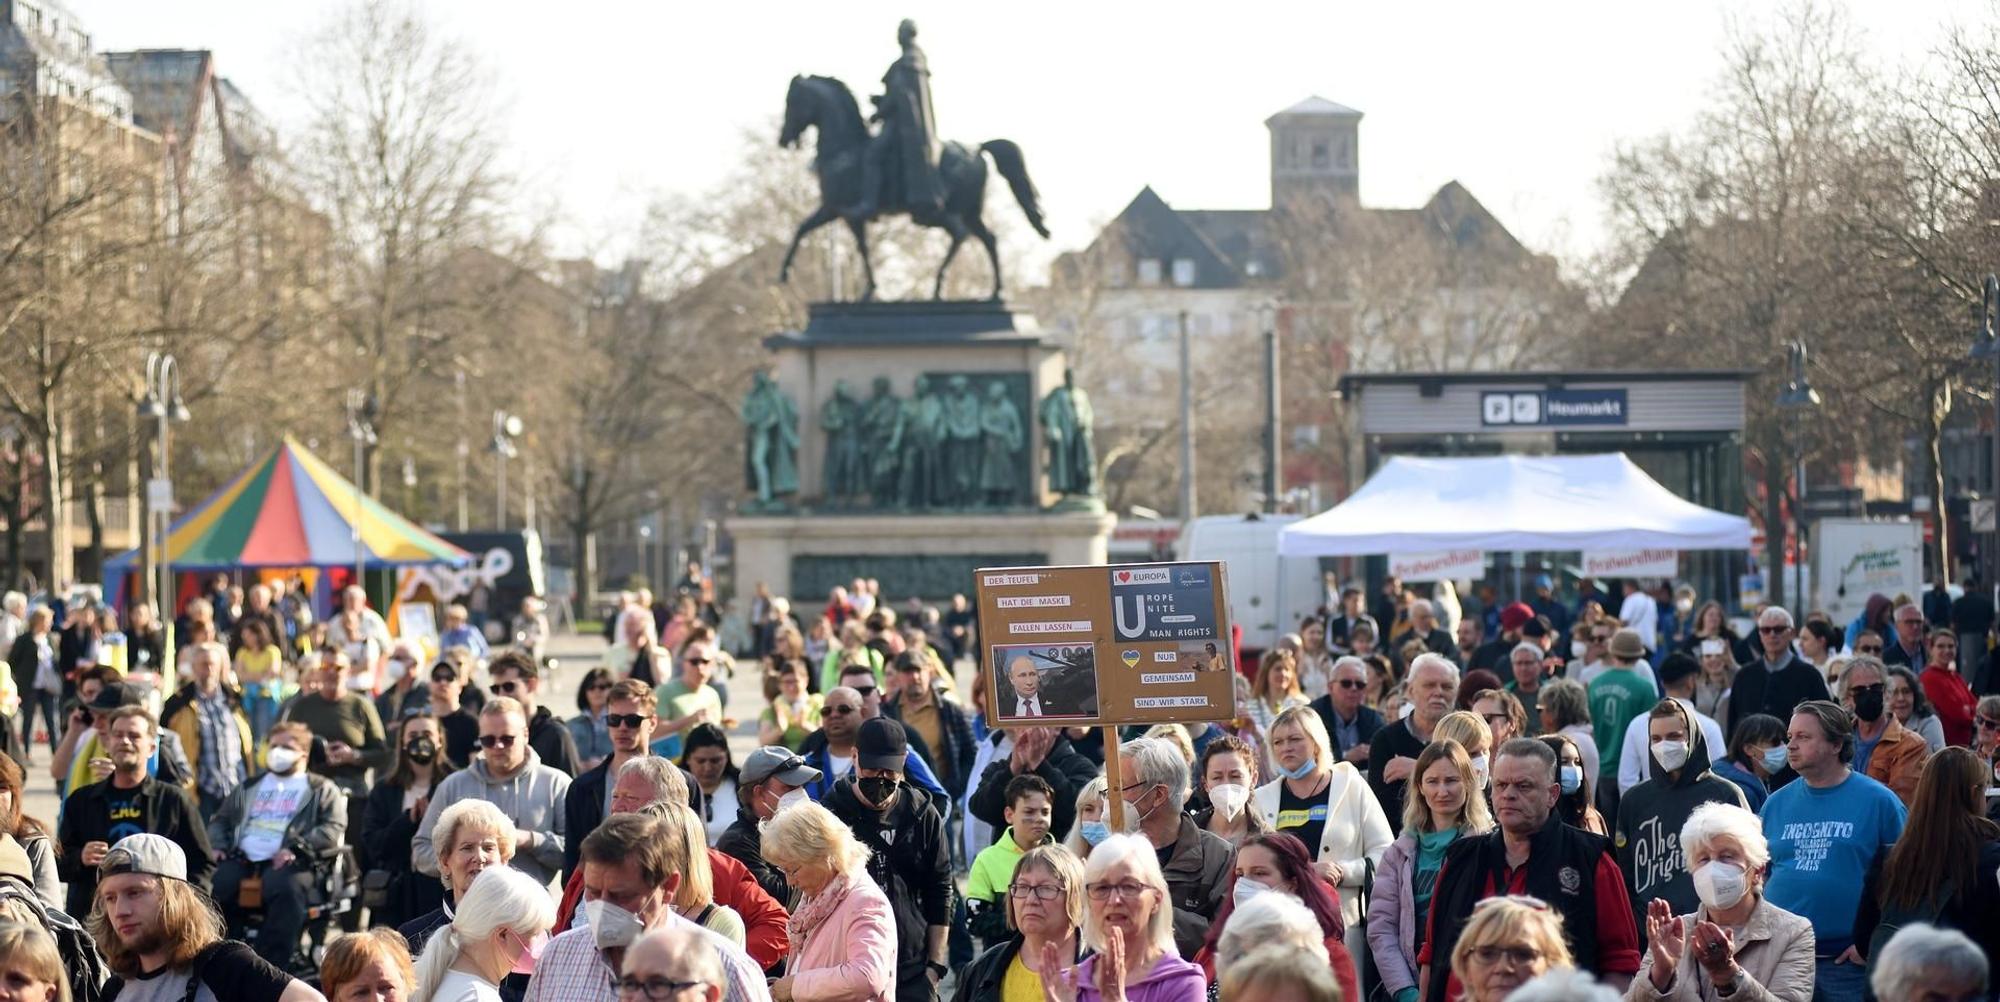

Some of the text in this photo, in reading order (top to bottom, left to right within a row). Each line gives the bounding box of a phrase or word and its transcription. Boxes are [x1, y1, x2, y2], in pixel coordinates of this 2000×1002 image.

[1548, 398, 1621, 416] Heumarkt
[989, 575, 1034, 585] DER TEUFEL
[1133, 572, 1167, 581] EUROPA
[1001, 597, 1065, 607] HAT DIE MASKE
[1146, 593, 1174, 602] ROPE
[1147, 605, 1175, 613] NITE
[1114, 595, 1146, 638] U
[1013, 624, 1040, 632] FALLEN
[1149, 627, 1211, 637] MAN RIGHTS
[1157, 653, 1175, 661] NUR
[1144, 673, 1193, 682] GEMEINSAM
[1136, 697, 1206, 707] SIND WIR STARK
[1780, 821, 1854, 840] INCOGNITO
[1639, 815, 1677, 861] The
